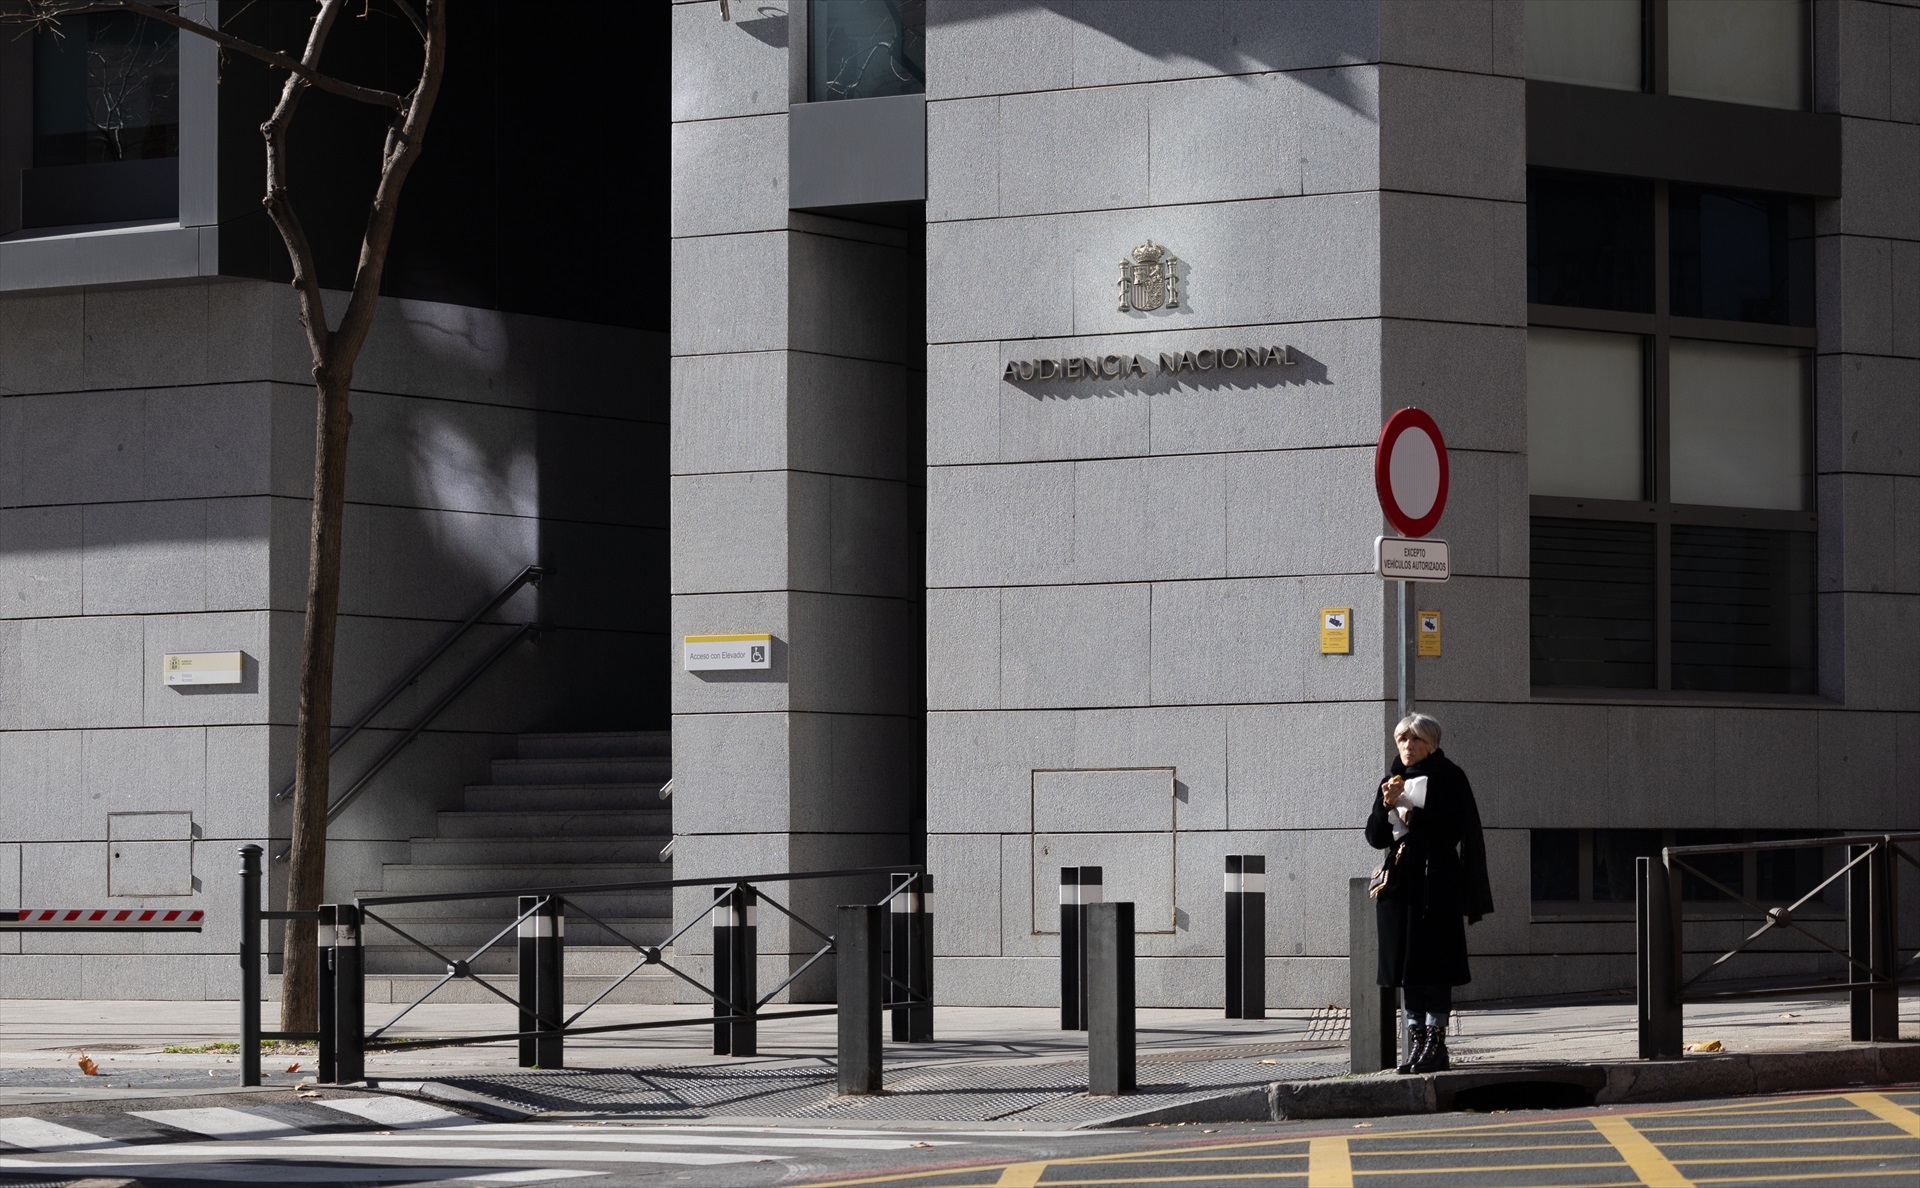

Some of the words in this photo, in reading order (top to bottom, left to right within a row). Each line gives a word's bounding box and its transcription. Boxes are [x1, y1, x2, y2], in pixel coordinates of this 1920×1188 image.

[1003, 354, 1147, 381] AUDIENCIA
[1157, 345, 1296, 372] NACIONAL
[1404, 548, 1426, 558] EXCEPTO
[1384, 558, 1411, 570] VEHÍCULOS
[1412, 561, 1446, 572] AUTORIZADOS
